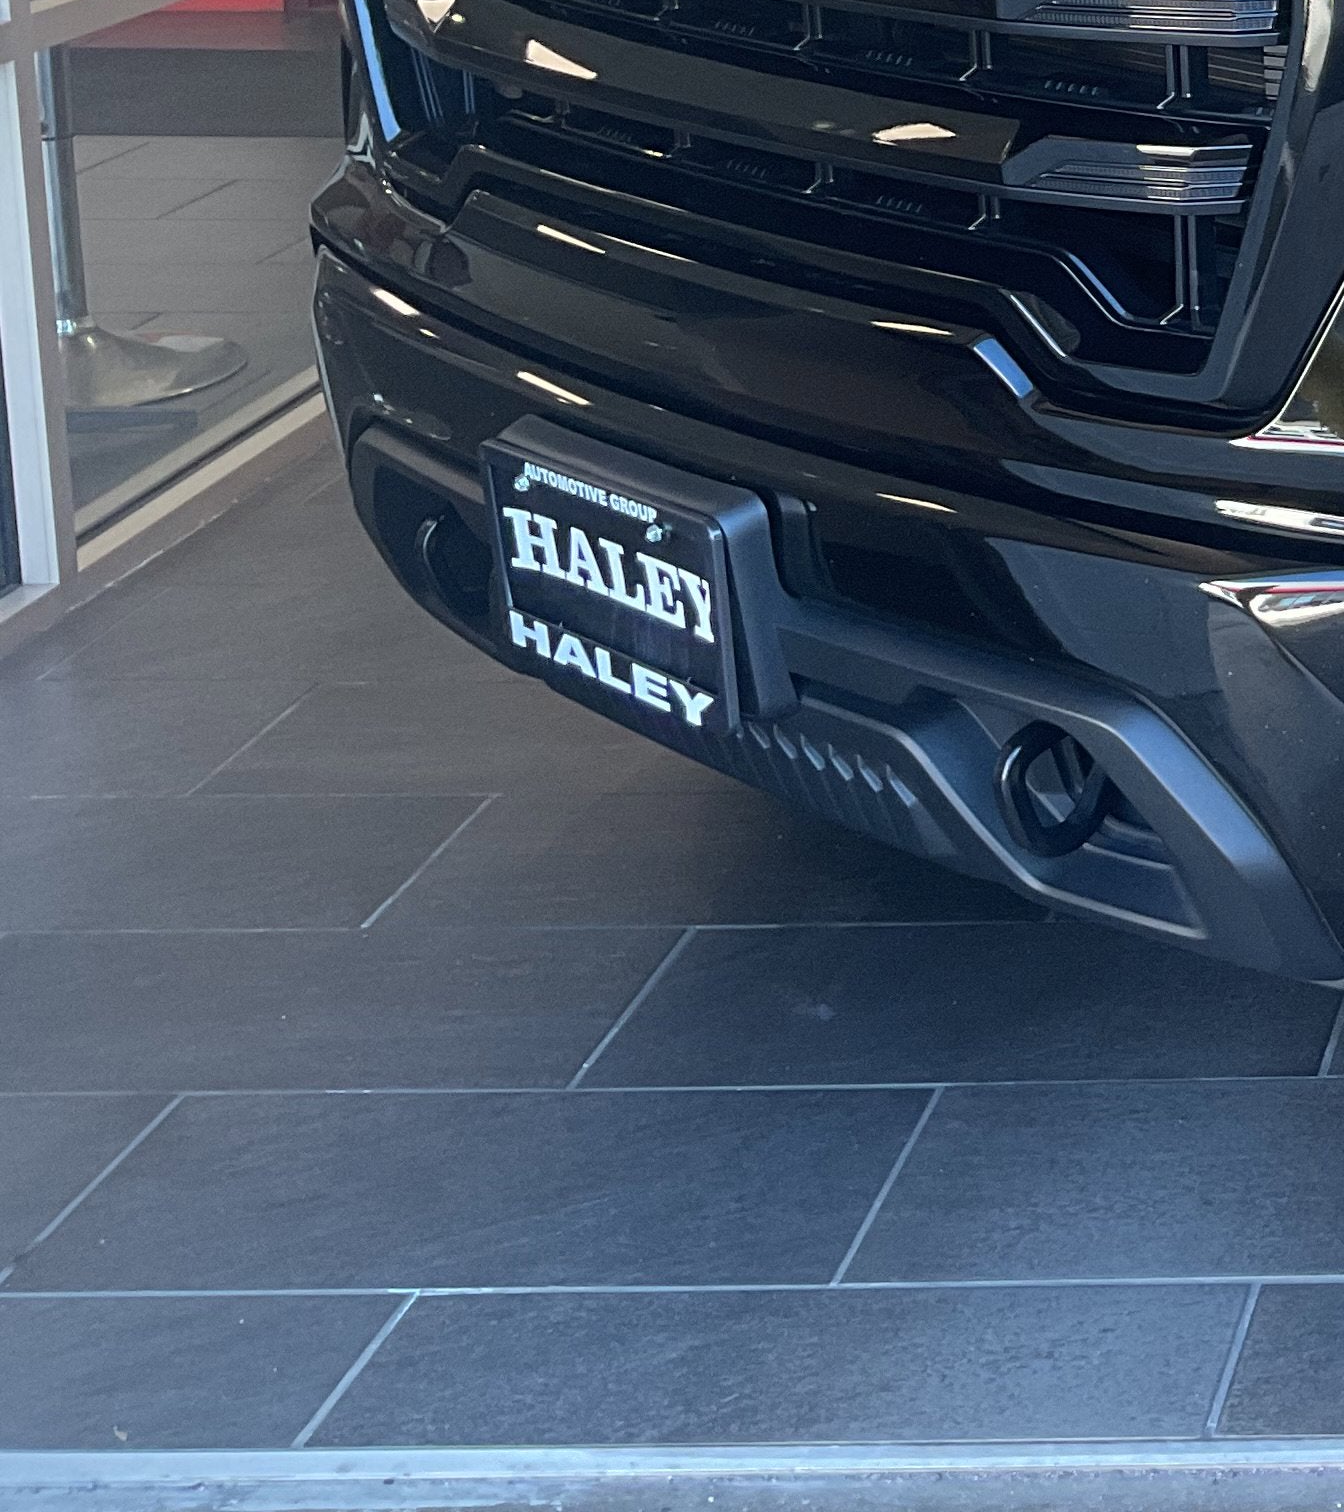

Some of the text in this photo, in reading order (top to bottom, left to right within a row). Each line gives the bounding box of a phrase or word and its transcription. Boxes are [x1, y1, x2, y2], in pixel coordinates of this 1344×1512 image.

[524, 461, 658, 524] AUTOMOTIVE GROUP
[503, 506, 716, 644] HALEY
[508, 609, 715, 727] HALEY
